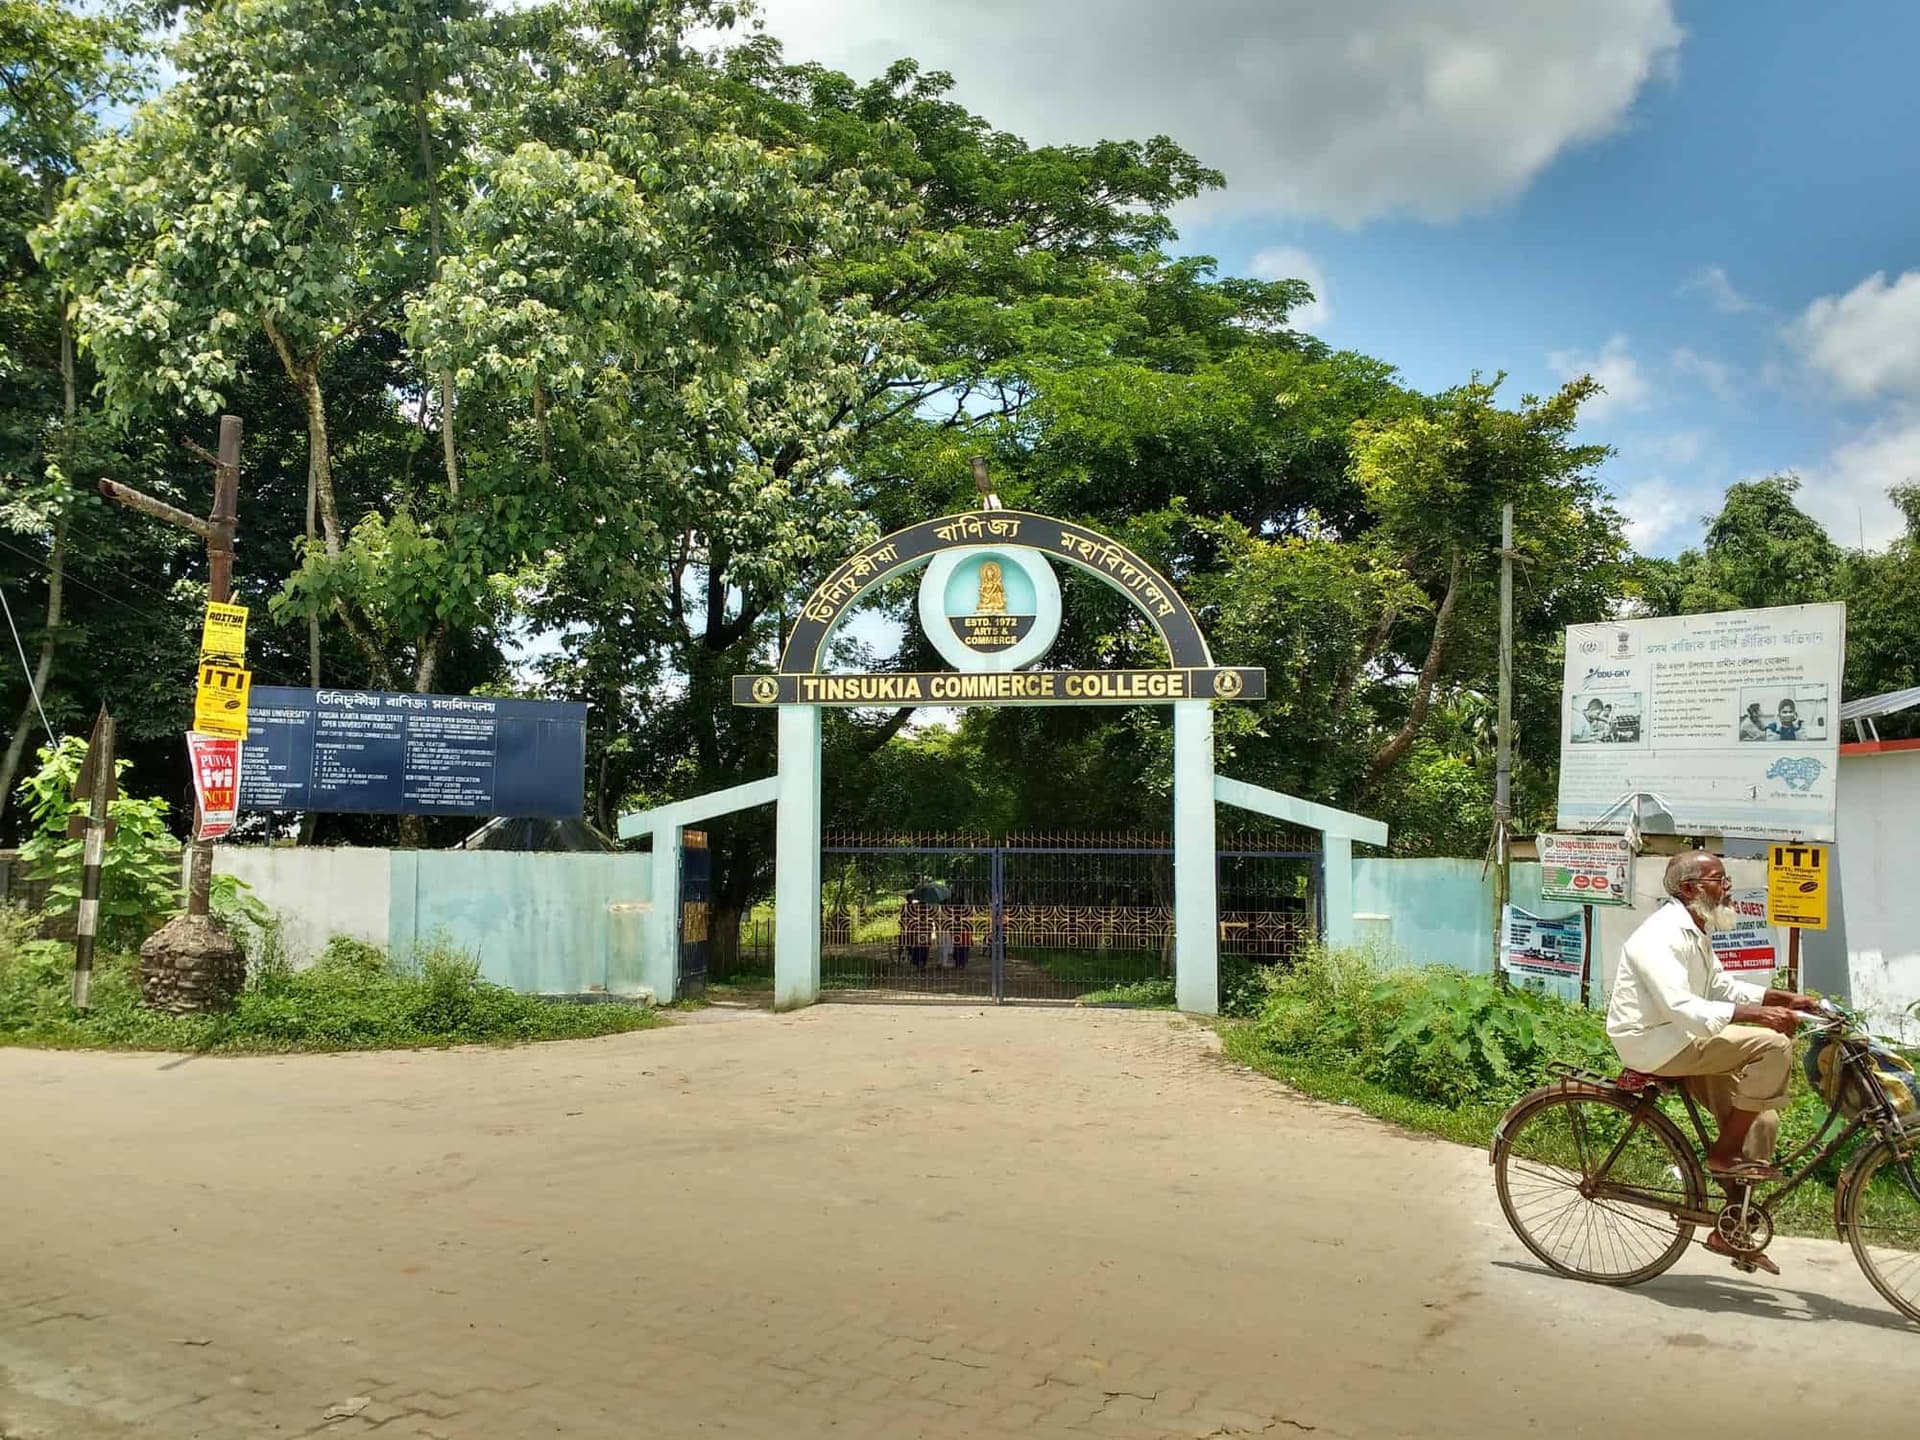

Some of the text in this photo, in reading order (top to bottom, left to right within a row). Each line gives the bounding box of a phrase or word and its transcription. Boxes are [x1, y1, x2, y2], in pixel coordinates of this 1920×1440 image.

[806, 516, 1175, 624] তিনিচুকীয়া বাণিজ্য মহাবিদ্যালয়
[209, 612, 244, 624] ADITYA
[965, 618, 1017, 626] ESTD. 1972
[965, 636, 1017, 644] COMMERCE
[204, 669, 244, 690] ITI
[803, 674, 1183, 699] TINSUKIA COMMERCE COLLEGE
[316, 691, 496, 713] তিনিচুকীয়া বাণিজ্য মহাবিদ্যালয়
[272, 709, 311, 718] UNIVERSITY
[386, 714, 403, 723] STATE
[321, 720, 336, 728] OPEN
[338, 721, 371, 729] UNIVERSITY
[200, 754, 232, 767] PUNYA
[1556, 841, 1617, 850] UNIQUE SOLUTION
[1775, 848, 1819, 867] ITI
[1741, 901, 1765, 917] GUEST
